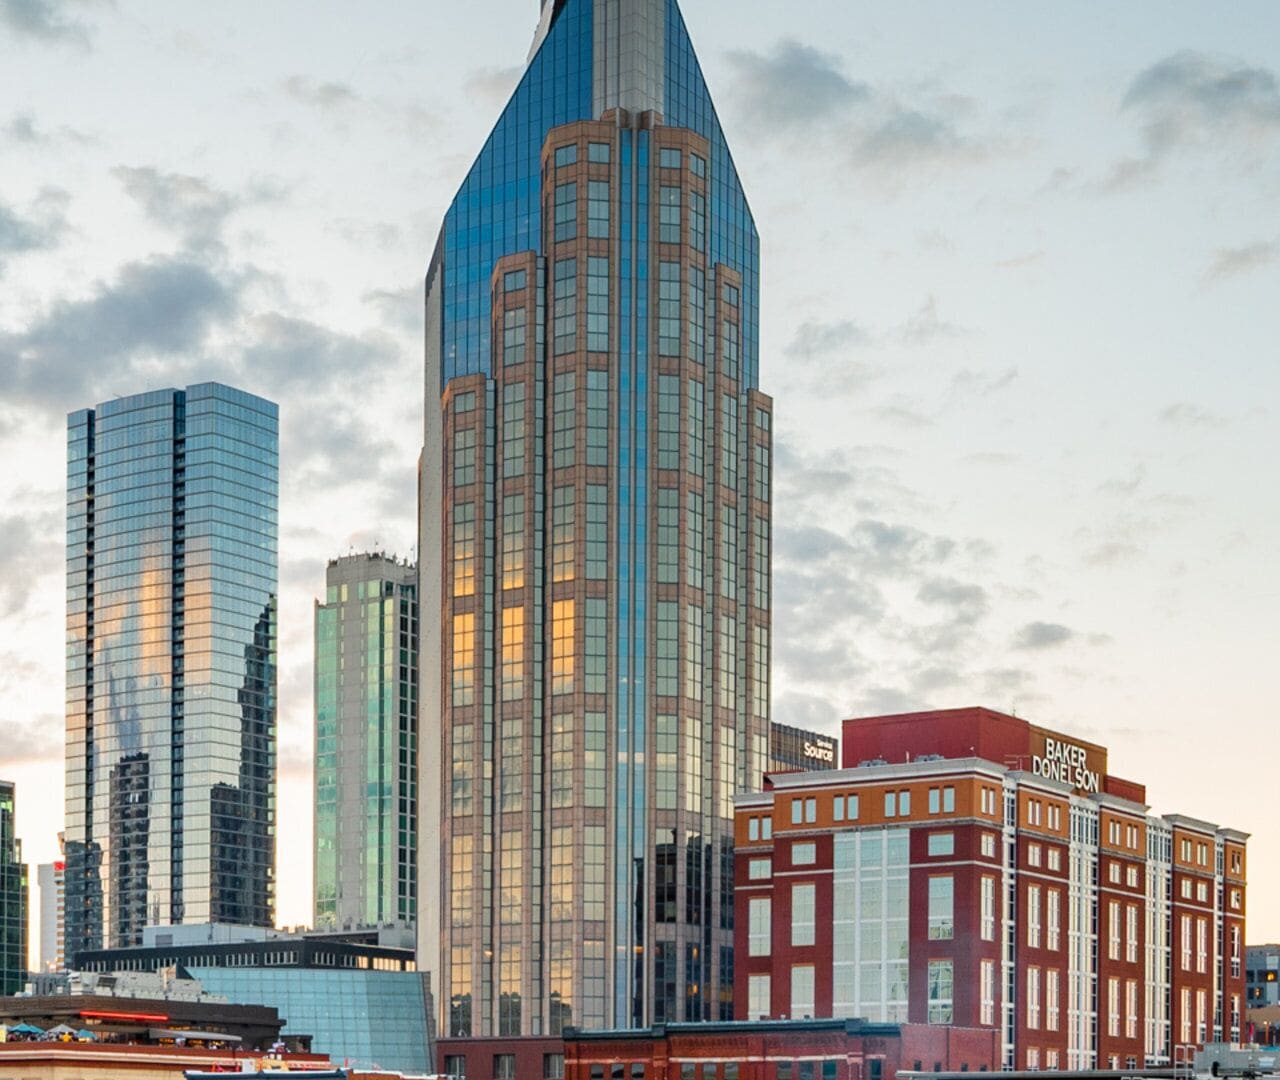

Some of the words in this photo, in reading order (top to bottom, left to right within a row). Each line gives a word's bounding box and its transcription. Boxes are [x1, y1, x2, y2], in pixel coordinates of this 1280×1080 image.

[804, 742, 833, 762] Source
[1046, 737, 1087, 770] BAKER
[1032, 755, 1099, 793] DONELSON
